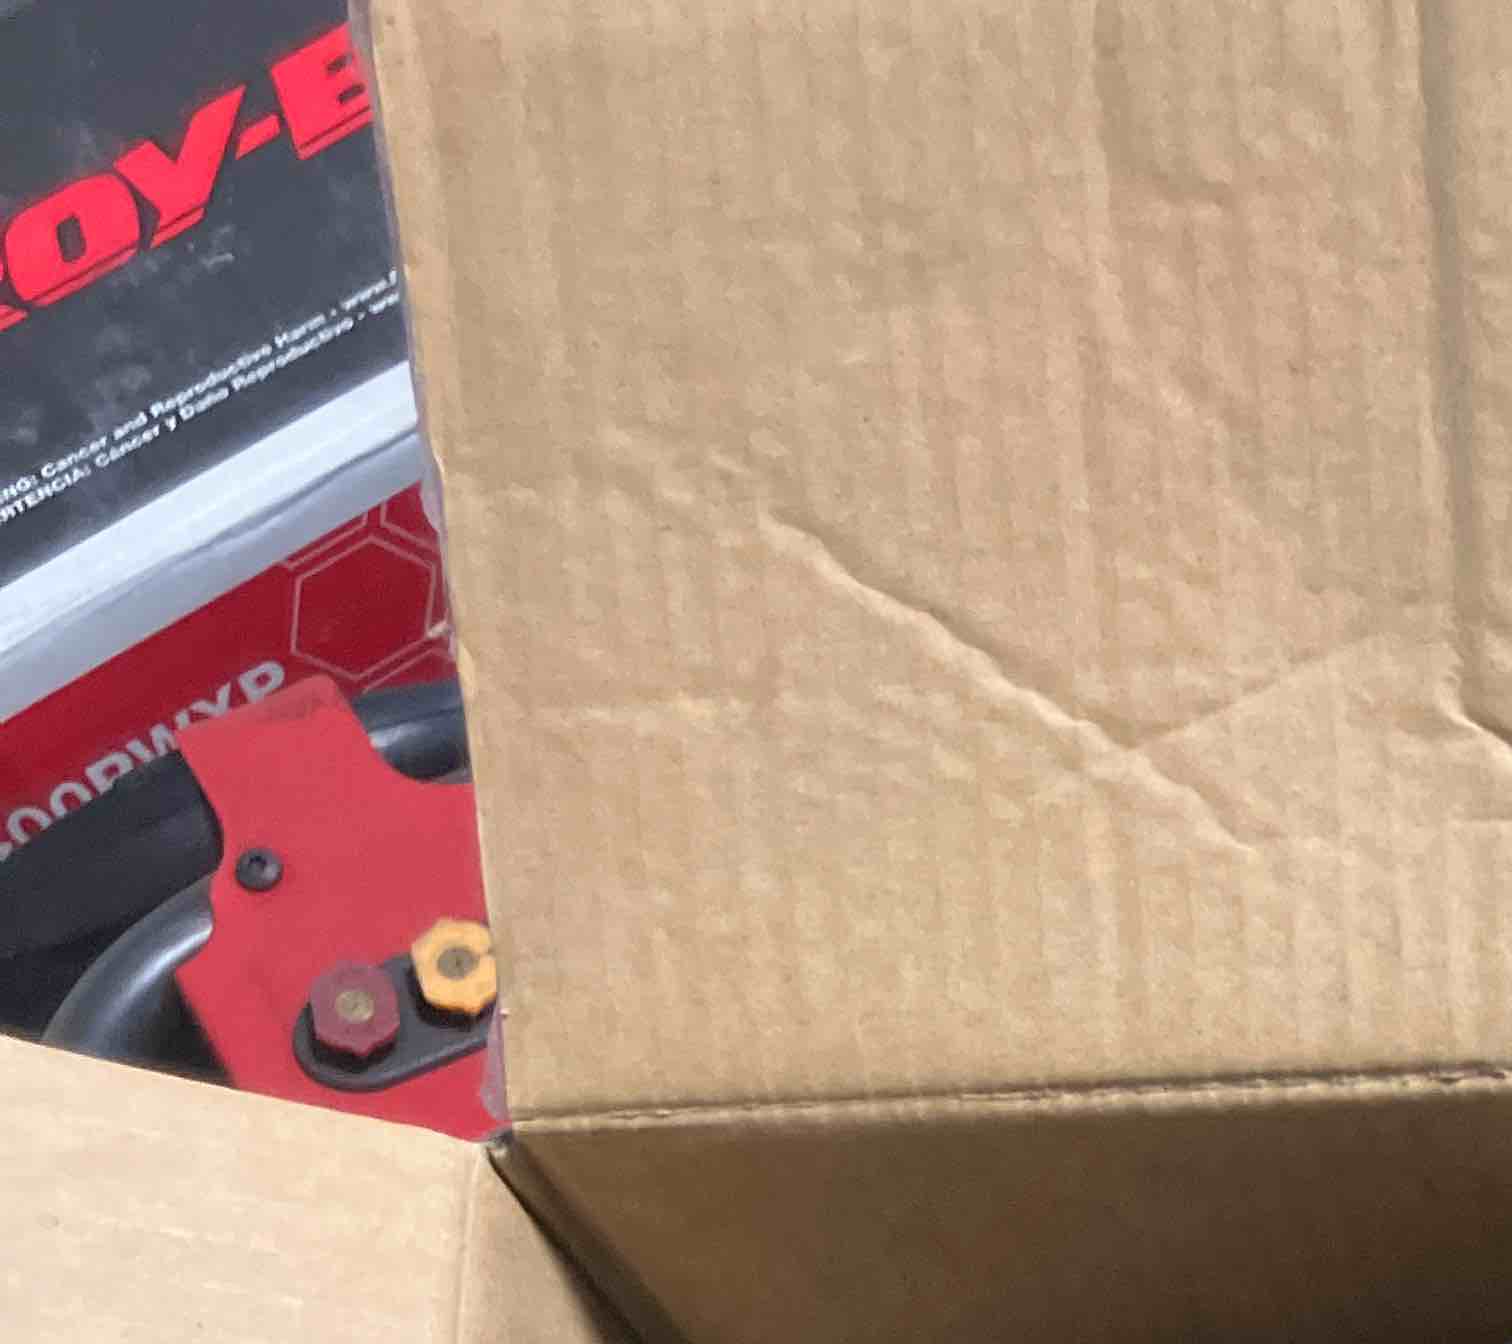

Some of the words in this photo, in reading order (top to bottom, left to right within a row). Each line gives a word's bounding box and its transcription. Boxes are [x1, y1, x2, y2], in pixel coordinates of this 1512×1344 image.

[0, 22, 373, 332] OY-B
[41, 436, 107, 478] Cancer
[114, 411, 148, 440] and
[150, 343, 272, 418] Reproductive
[274, 313, 326, 348] Harm
[164, 415, 177, 432] y
[231, 317, 354, 392] Reproductivo
